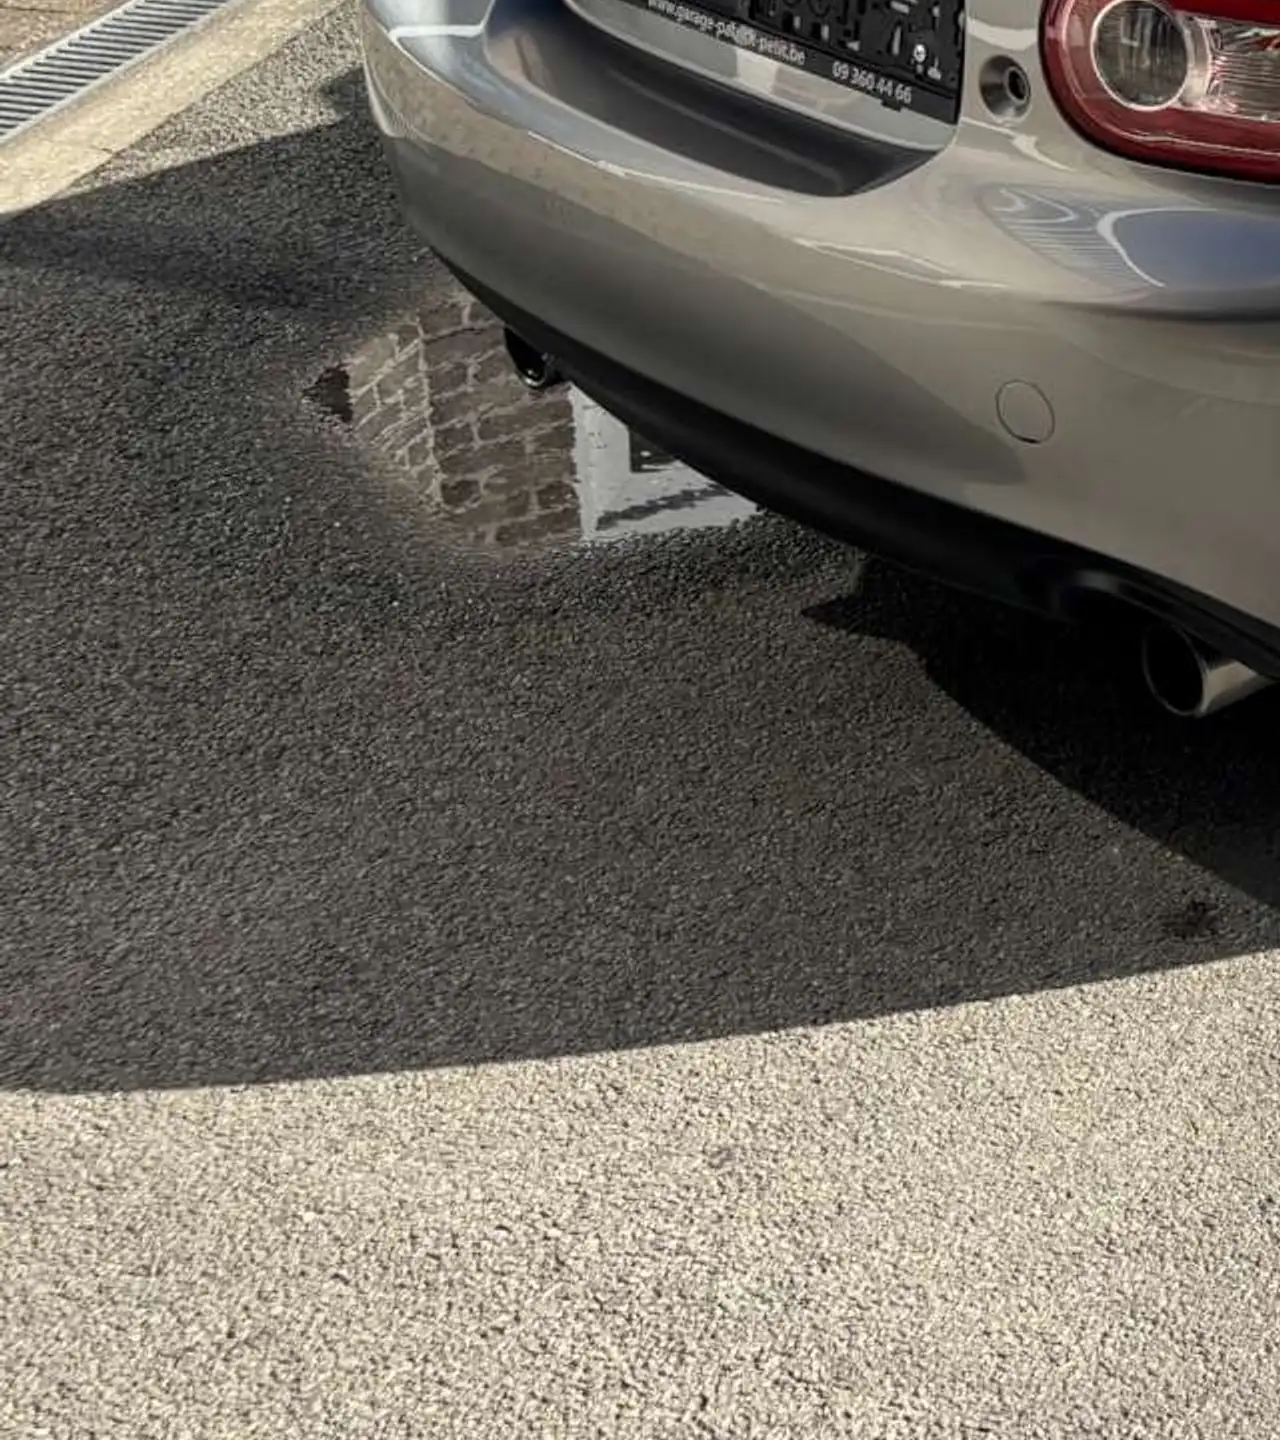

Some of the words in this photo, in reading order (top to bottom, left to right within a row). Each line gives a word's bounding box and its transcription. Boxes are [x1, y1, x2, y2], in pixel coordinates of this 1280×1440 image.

[832, 61, 849, 79] 09
[850, 66, 876, 91] 360
[876, 77, 894, 97] 44
[895, 83, 913, 104] 66
